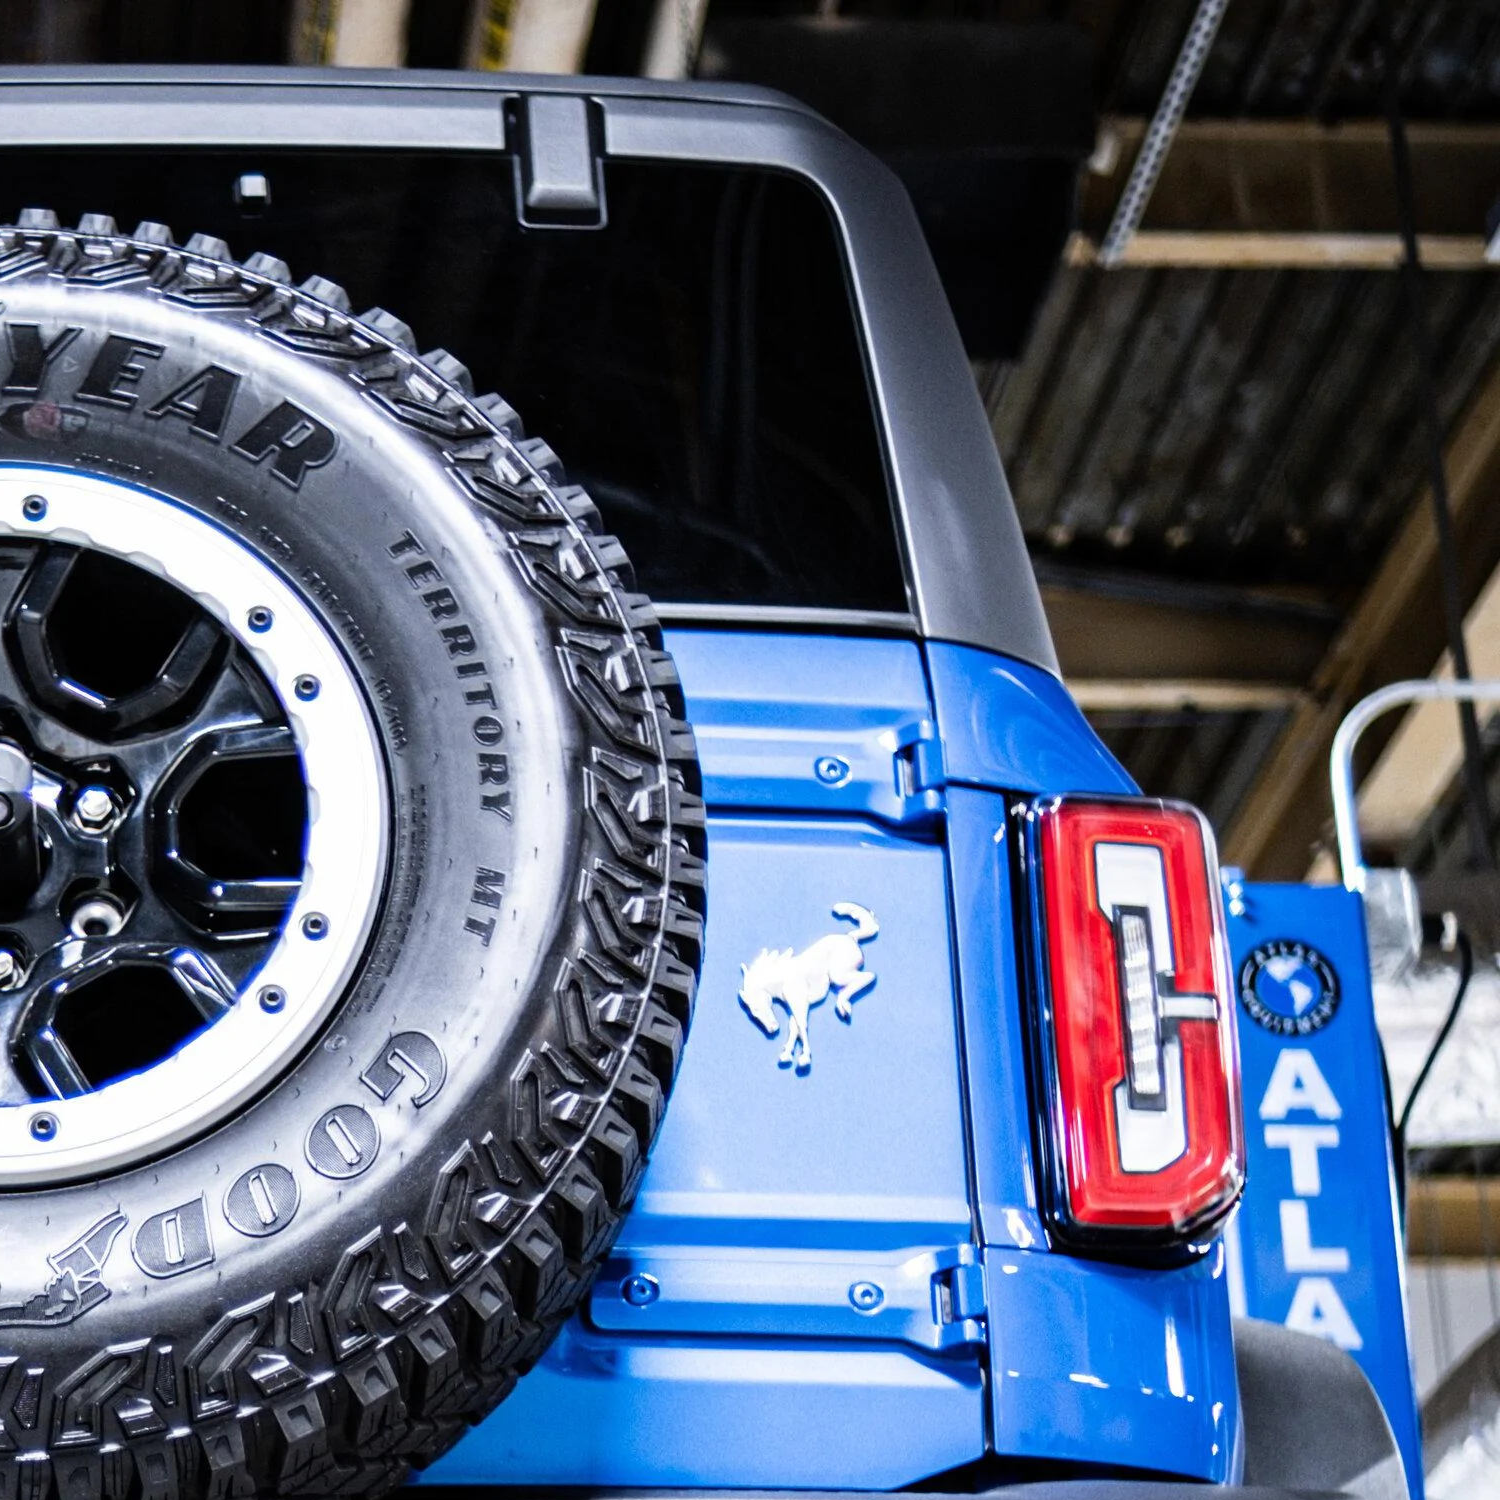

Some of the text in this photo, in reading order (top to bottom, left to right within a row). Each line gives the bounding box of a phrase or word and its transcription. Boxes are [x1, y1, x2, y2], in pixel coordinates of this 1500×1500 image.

[384, 528, 514, 823] TERRITORY
[463, 865, 507, 947] MT
[1258, 1048, 1364, 1352] ATLA
